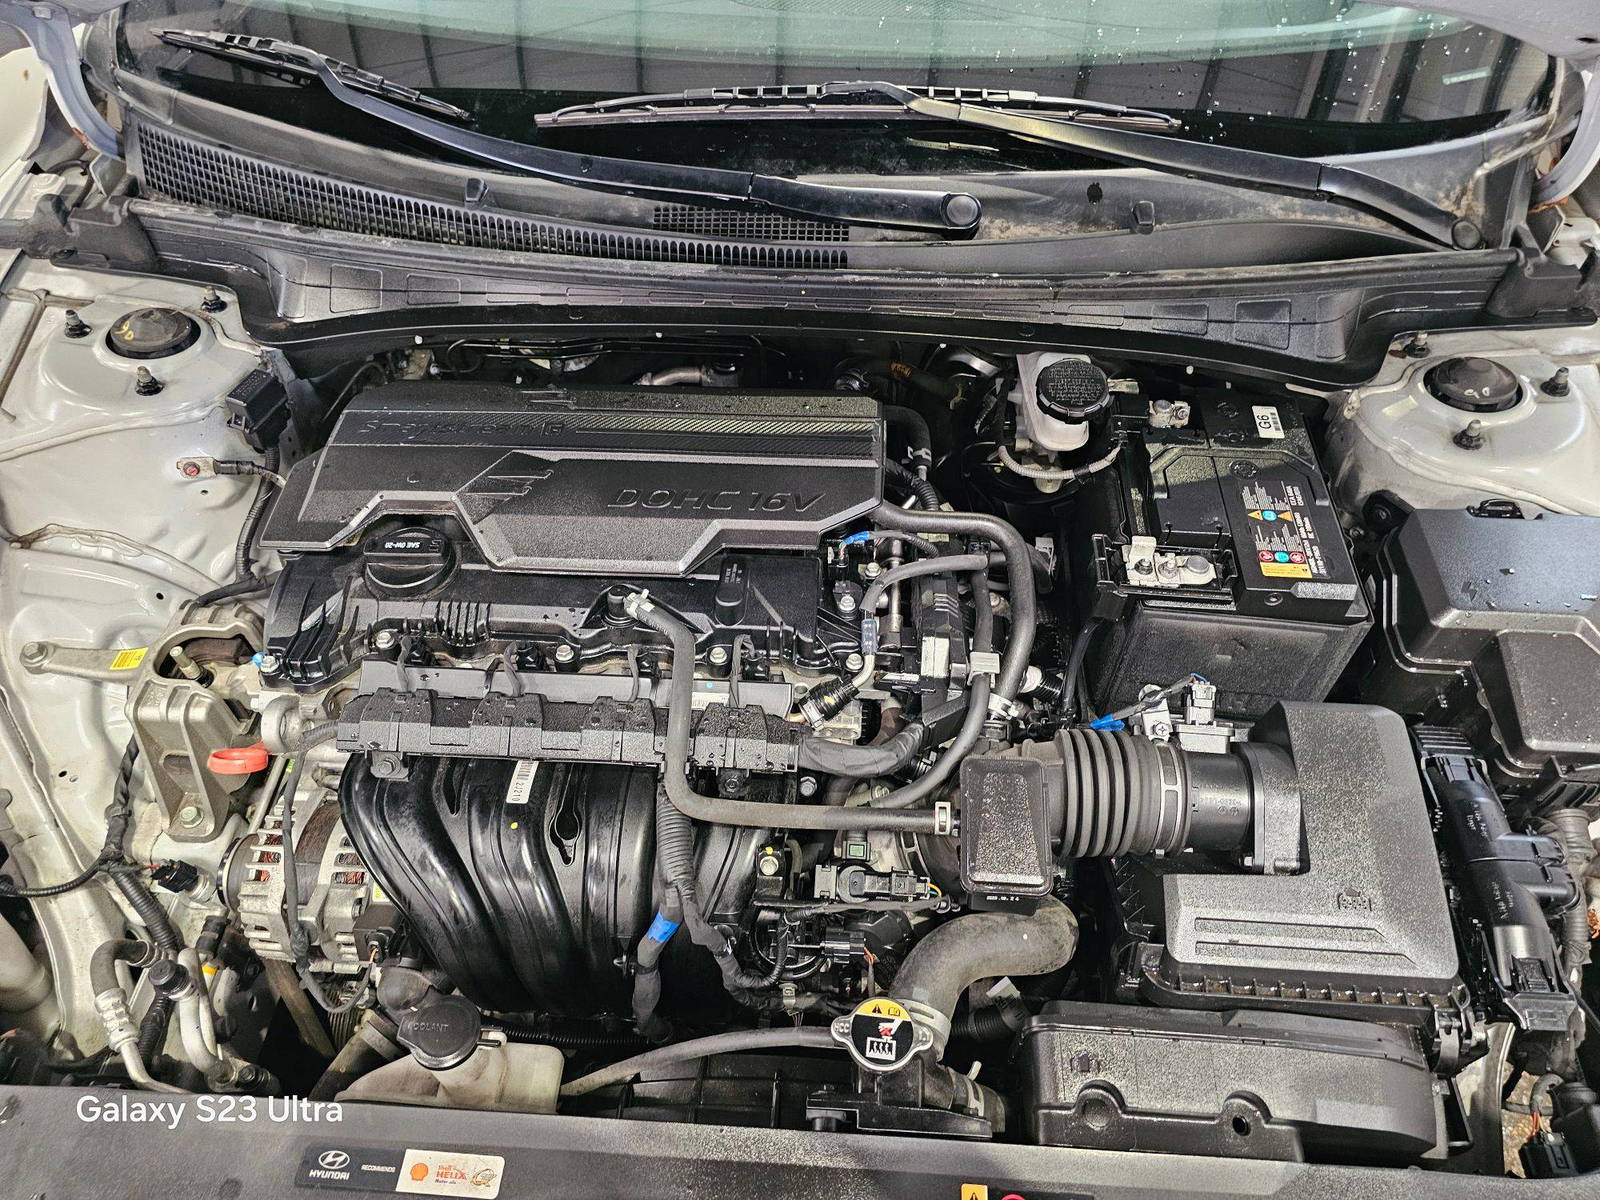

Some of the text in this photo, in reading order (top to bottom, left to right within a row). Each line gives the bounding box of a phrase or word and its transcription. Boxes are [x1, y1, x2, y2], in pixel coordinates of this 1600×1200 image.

[1257, 414, 1272, 429] G6
[607, 488, 827, 513] DOHC 16V
[309, 1169, 350, 1181] HYUNDAI
[436, 1169, 468, 1181] HELIX
